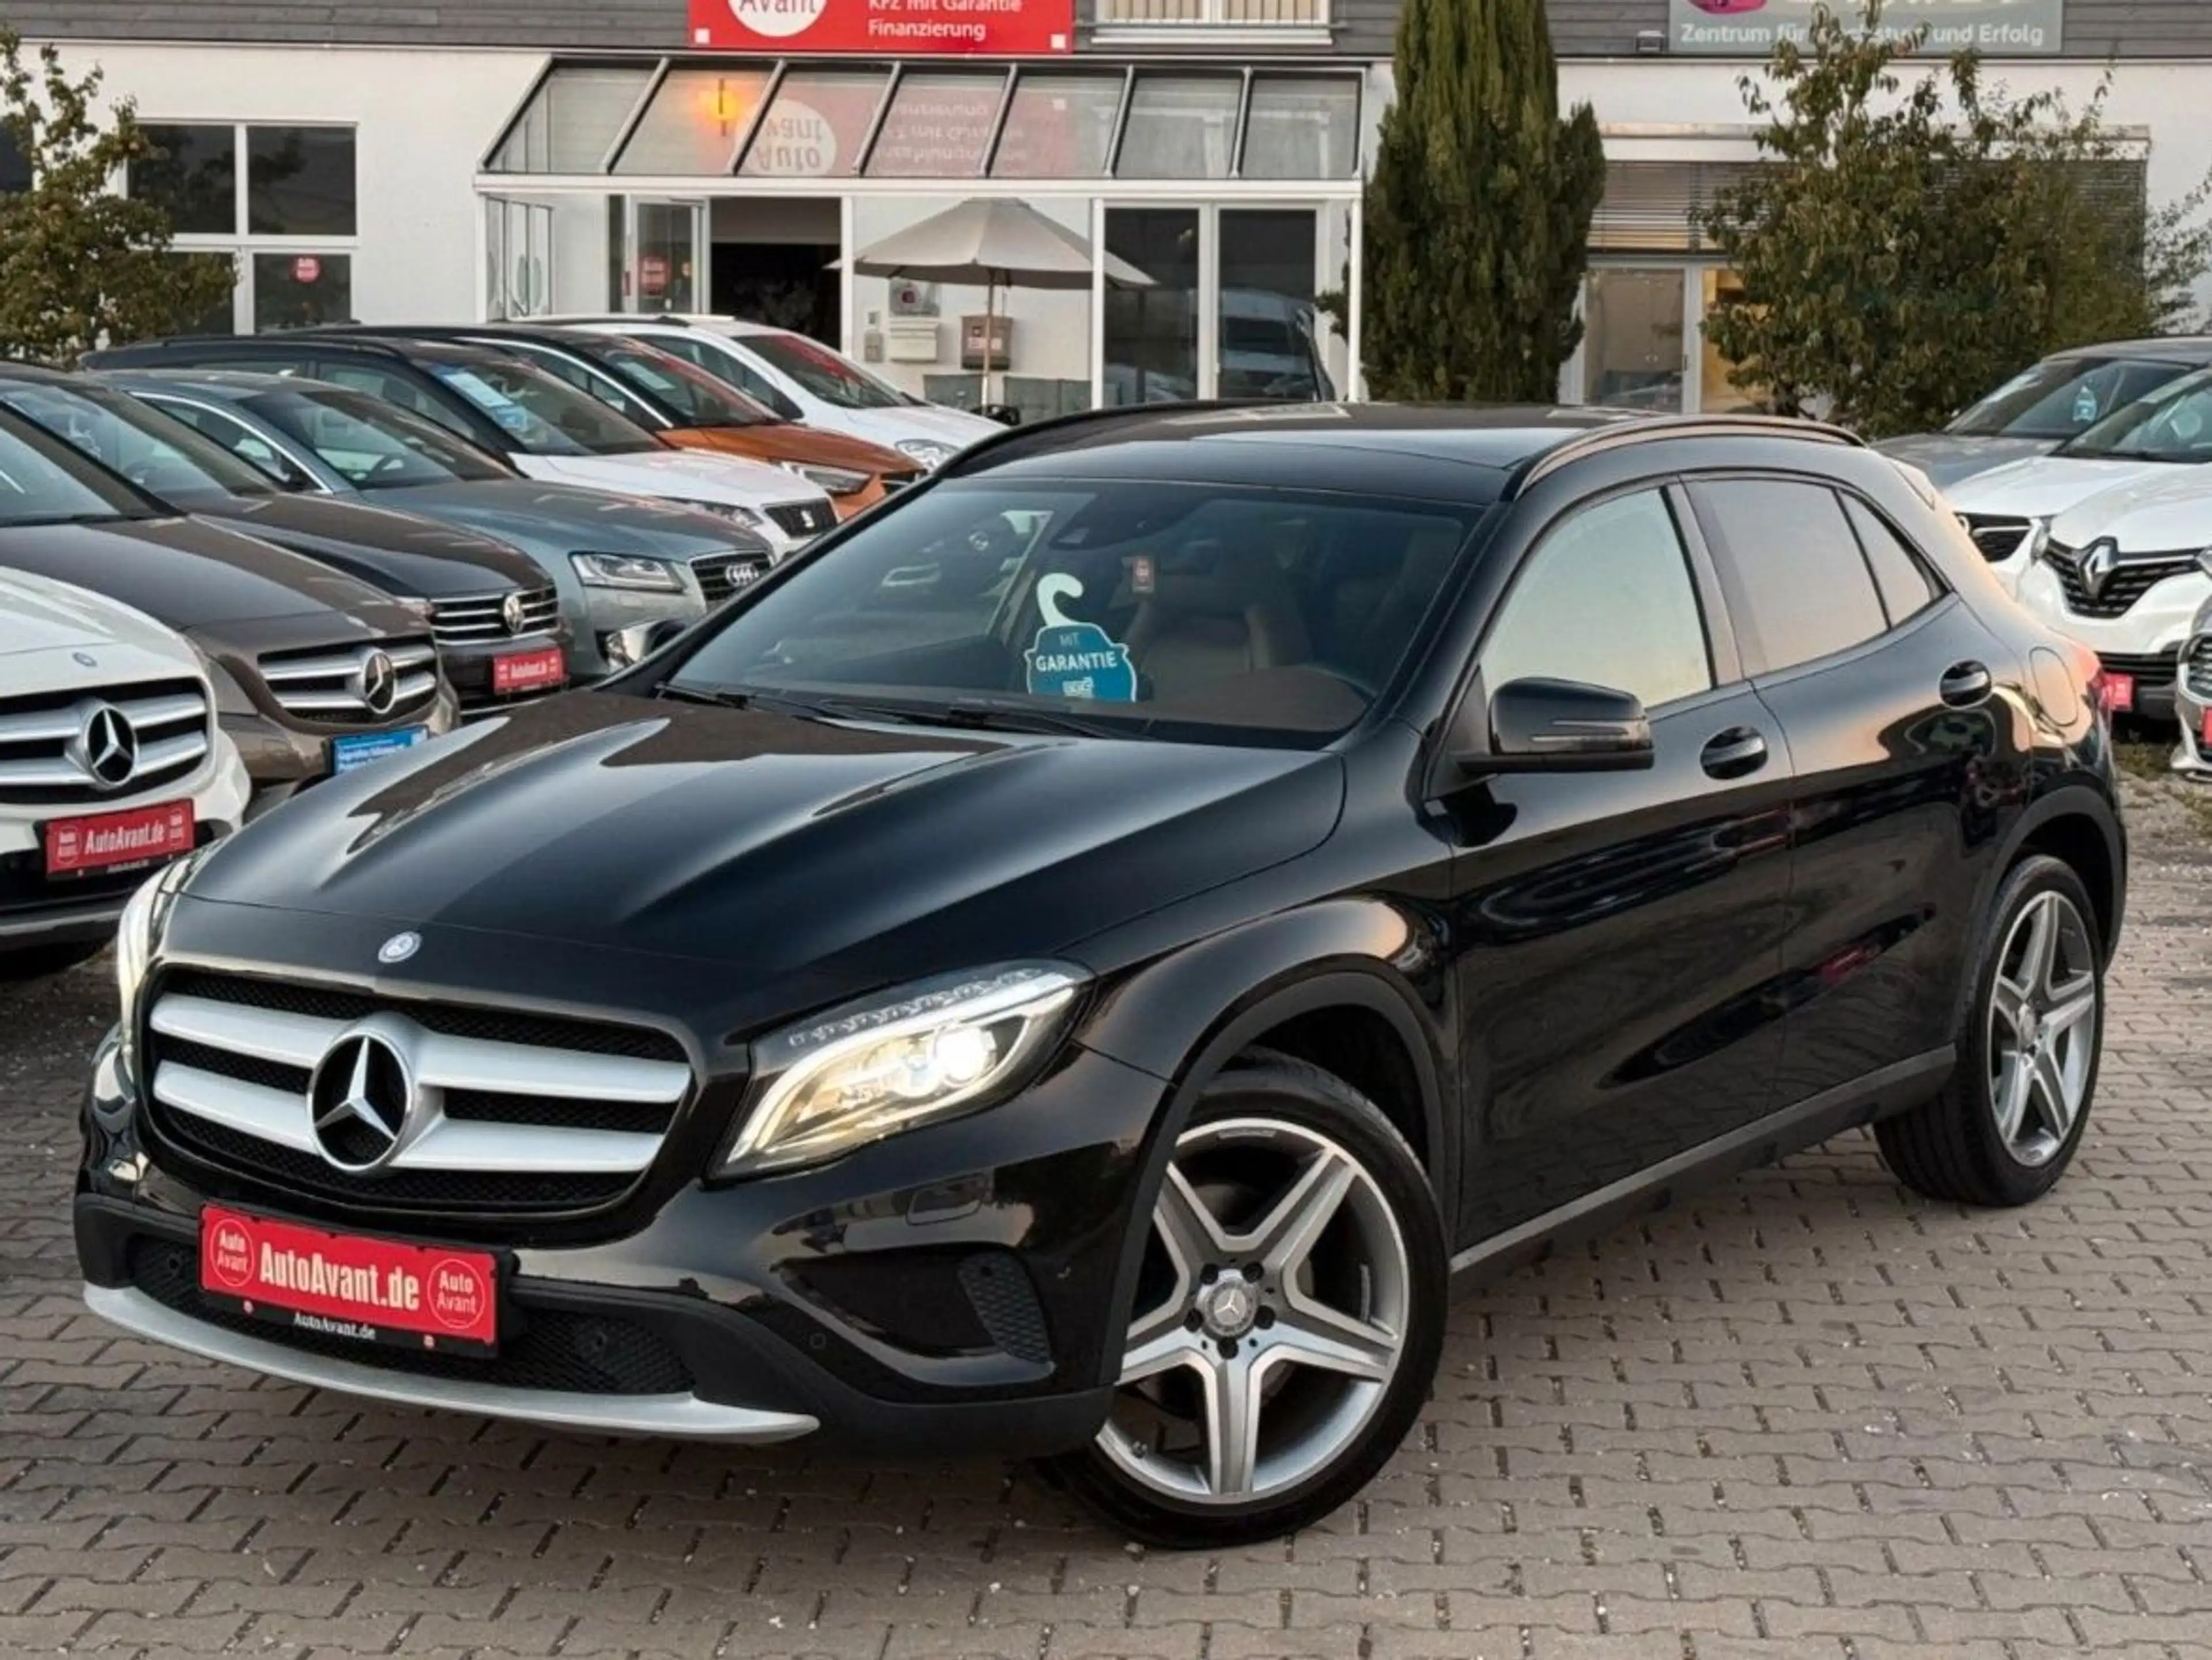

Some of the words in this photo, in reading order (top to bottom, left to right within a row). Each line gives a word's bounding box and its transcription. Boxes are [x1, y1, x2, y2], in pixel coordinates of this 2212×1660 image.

[907, 0, 938, 11] mit
[943, 0, 1022, 12] Garantie
[868, 18, 986, 42] Finanzierung
[1680, 23, 1772, 43] Zentrum
[1933, 23, 1973, 43] und
[1979, 23, 2043, 46] Erfolg
[1035, 651, 1117, 672] GARANTIE
[219, 1228, 246, 1252] Auto
[259, 1241, 420, 1311] AutoAvant.de
[439, 1270, 474, 1295] Auto
[436, 1290, 477, 1315] Avant
[293, 1311, 376, 1341] AutoAvant.de
